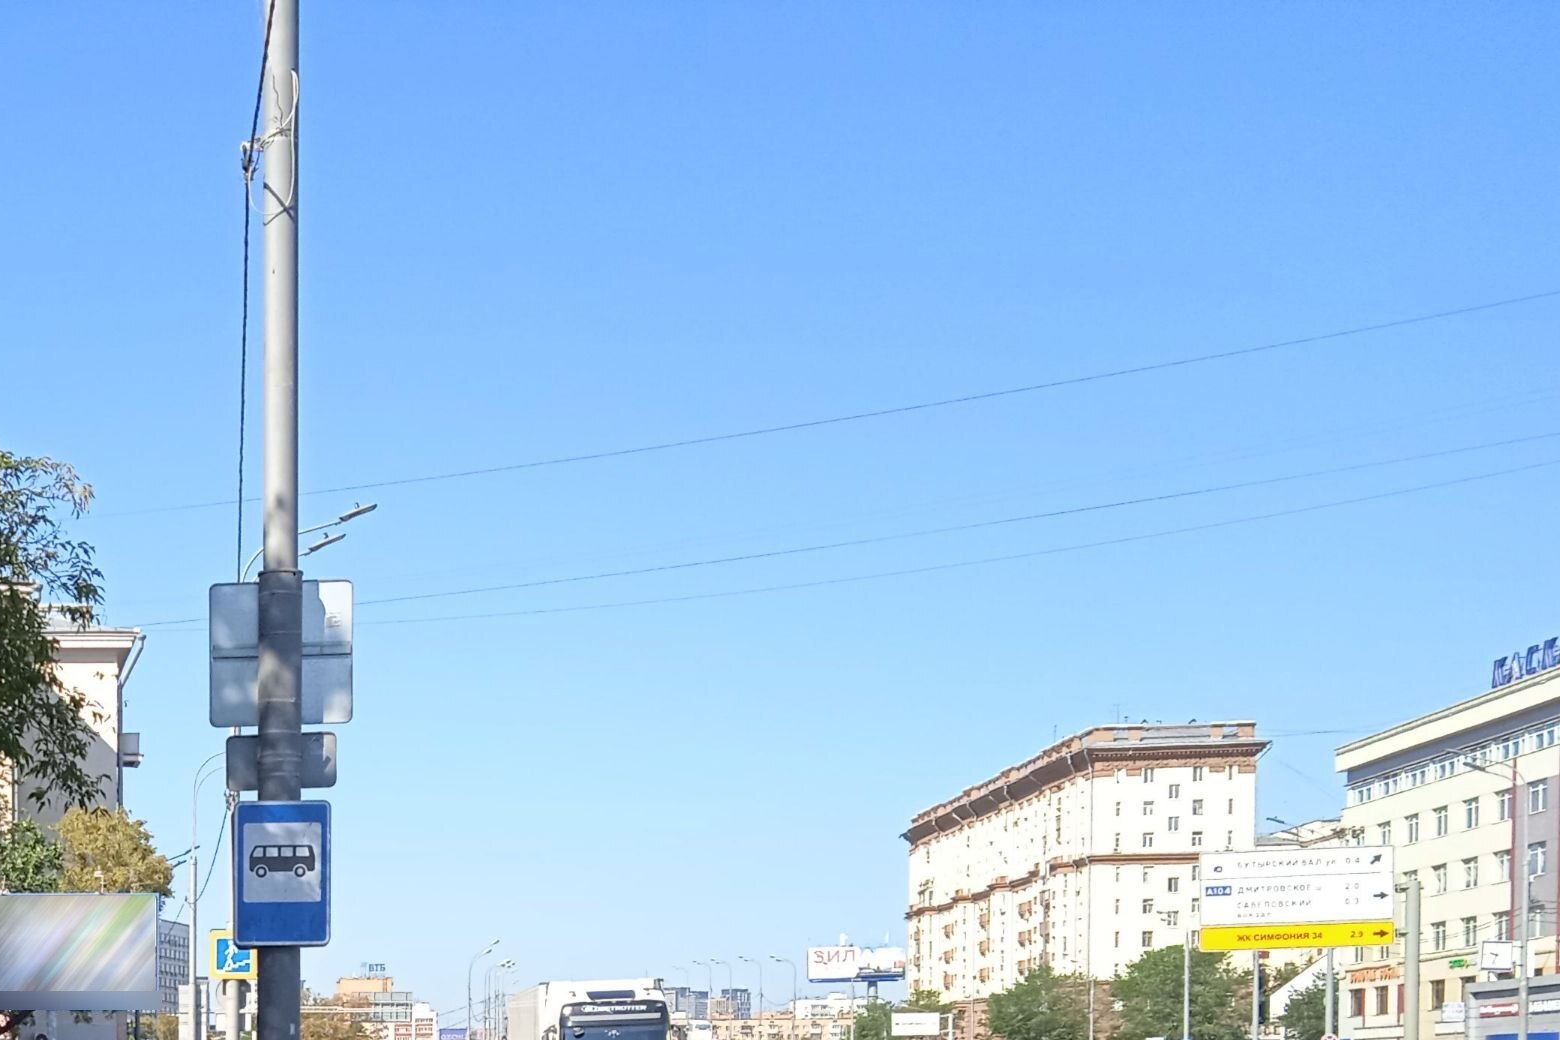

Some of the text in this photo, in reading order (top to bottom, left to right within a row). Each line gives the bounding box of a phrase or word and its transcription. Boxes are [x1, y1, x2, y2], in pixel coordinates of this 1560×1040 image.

[1237, 934, 1251, 942] ЖК
[1253, 932, 1310, 942] СИМФОНИЯ
[368, 963, 386, 972] ВТБ
